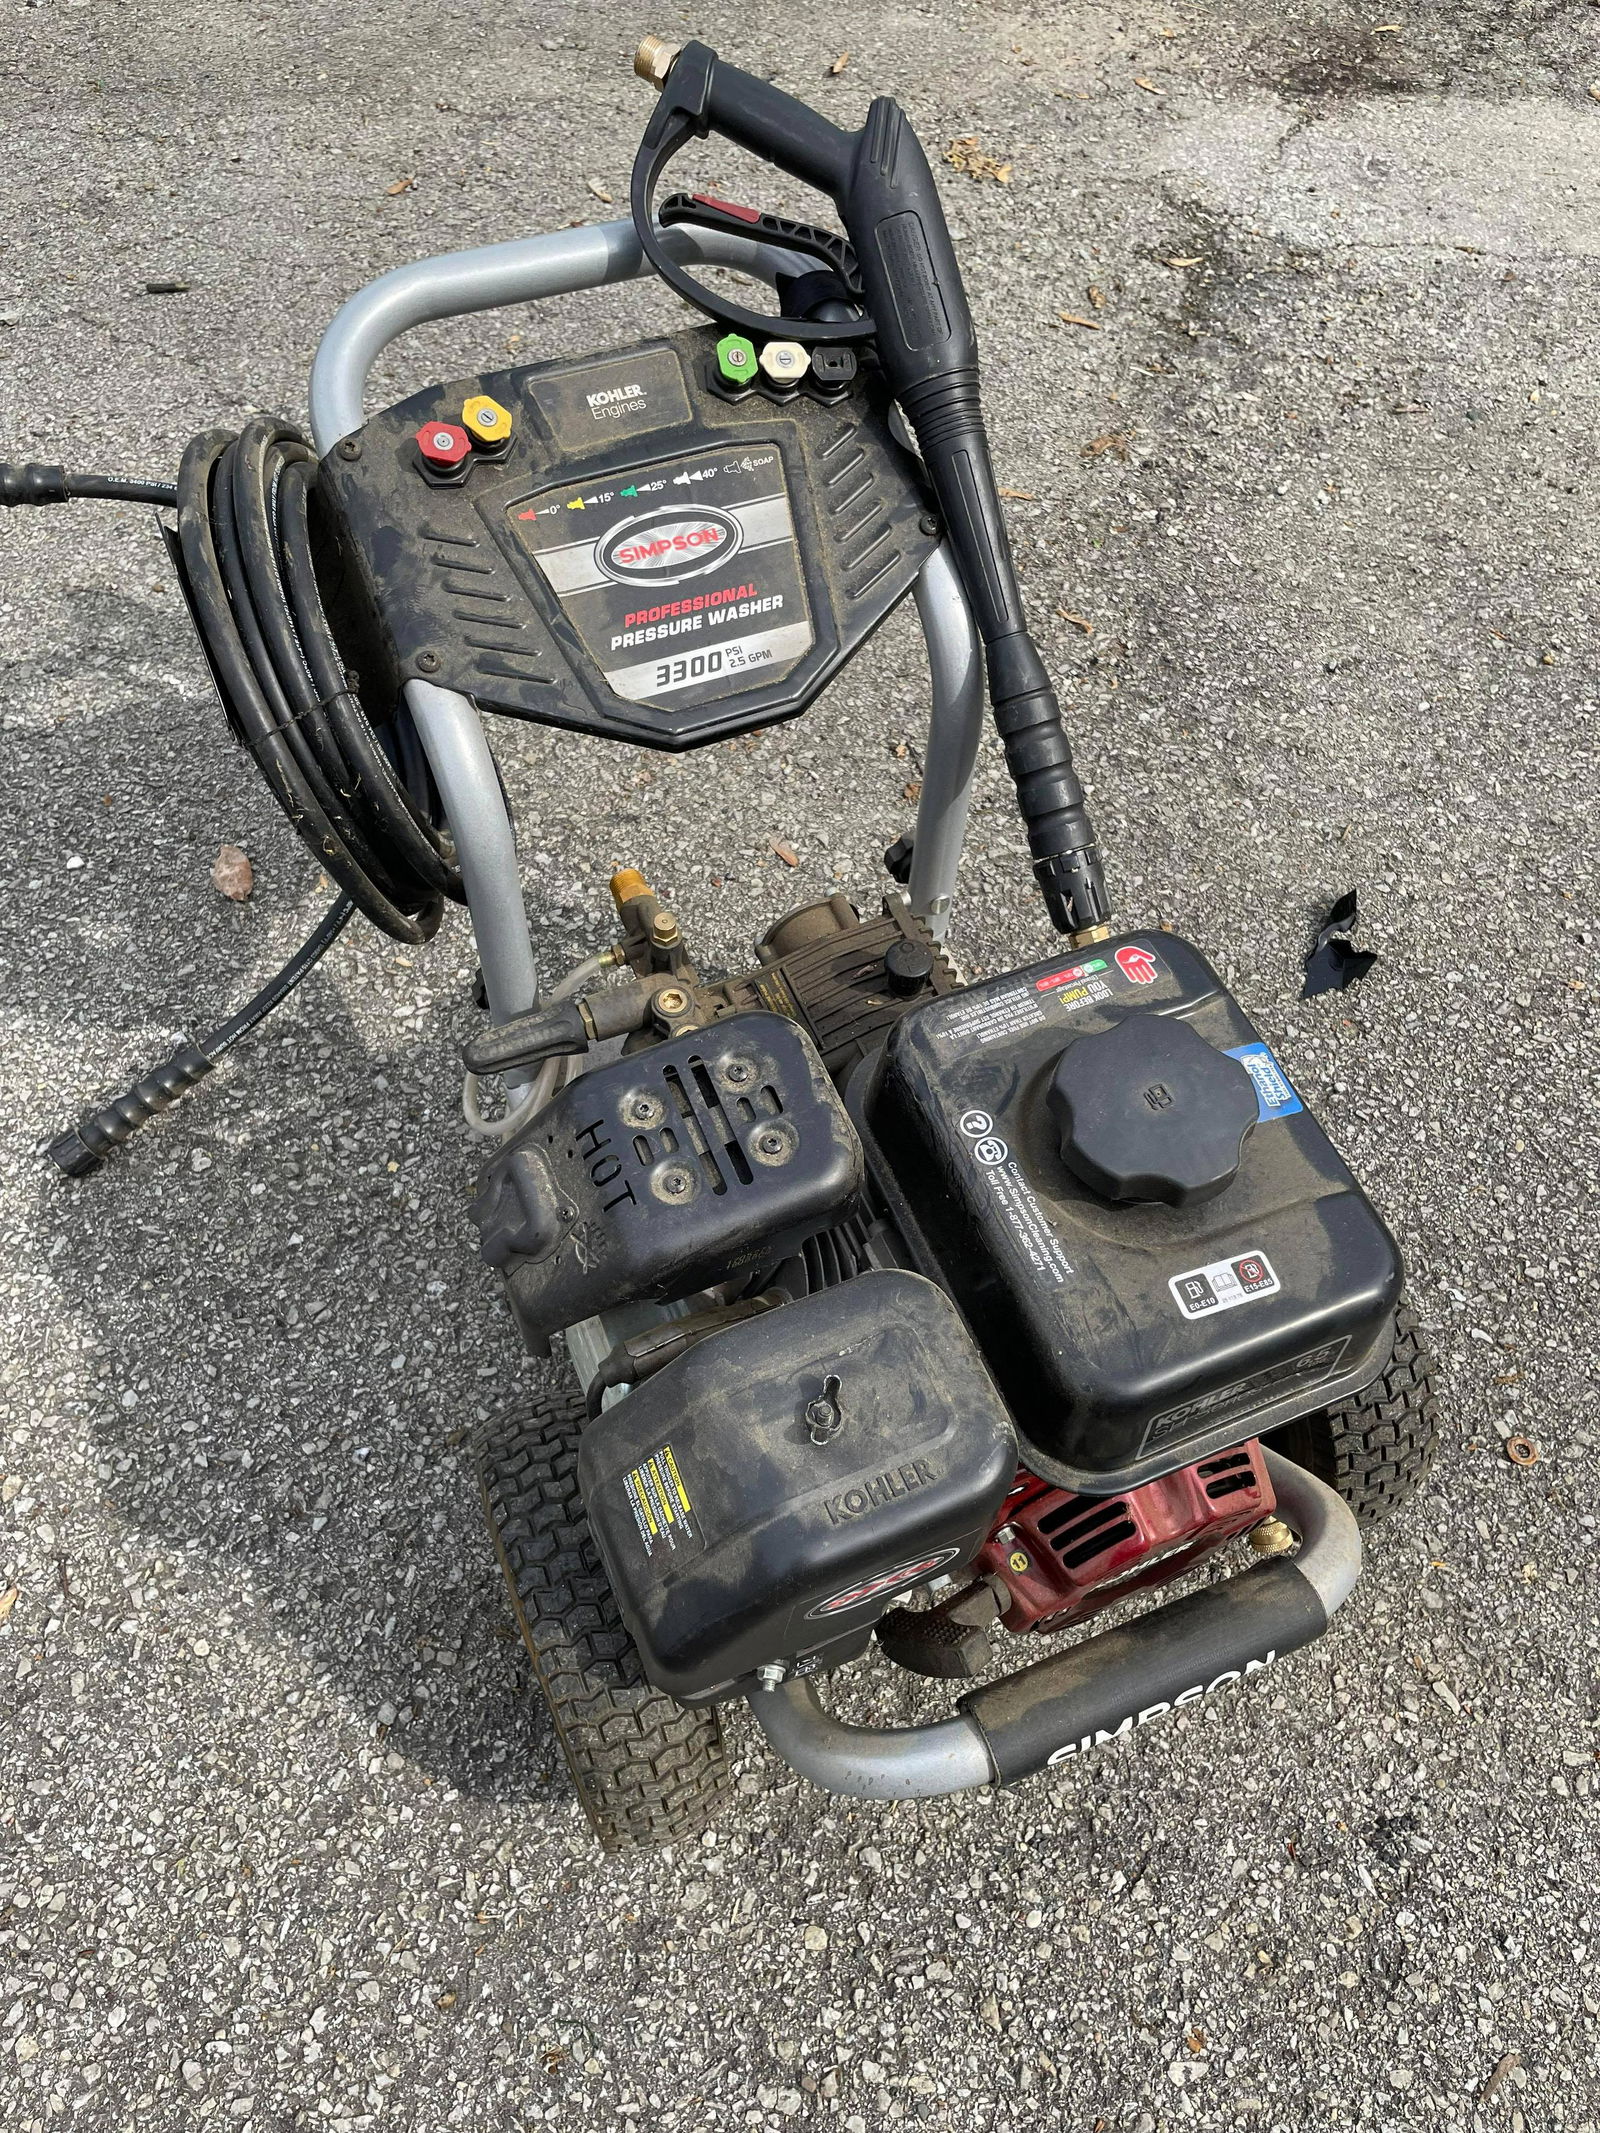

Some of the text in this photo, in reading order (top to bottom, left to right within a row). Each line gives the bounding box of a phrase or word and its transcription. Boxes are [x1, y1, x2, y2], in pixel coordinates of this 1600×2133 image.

[592, 399, 646, 420] Engines
[702, 468, 718, 479] 40°
[752, 456, 774, 467] SOAP
[597, 492, 614, 504] 15°
[650, 480, 667, 492] 25°
[550, 504, 561, 515] 0°
[618, 527, 718, 564] SIMPSON
[624, 583, 758, 628] PROFESSIONAL
[611, 594, 784, 651] PRESSURE WASHER
[726, 646, 743, 657] PSI
[730, 650, 772, 668] 2.5 GPM
[656, 651, 722, 687] 3300
[1057, 986, 1089, 1003] PUMP!
[1063, 988, 1113, 1011] LOOK BEFORE
[1086, 979, 1108, 993] YOU
[1246, 1063, 1278, 1104] Ethanol
[1260, 1066, 1285, 1098] Shield
[576, 1119, 636, 1212] HOT
[984, 1170, 1046, 1271] Toll Free 1-877-362-4271
[993, 1166, 1066, 1283] www.SimpsonCleaning.com
[1006, 1161, 1074, 1274] Contact Customer Support
[1244, 1278, 1273, 1293] E15-E85
[1190, 1297, 1216, 1311] E0-E10
[1155, 1382, 1248, 1427] KOHLER
[650, 1469, 667, 1505] ATTENTION
[666, 1457, 681, 1487] CAUTION
[824, 1459, 938, 1526] KOHLER
[1012, 1556, 1026, 1569] 11
[1046, 1650, 1277, 1767] SIMPSON
